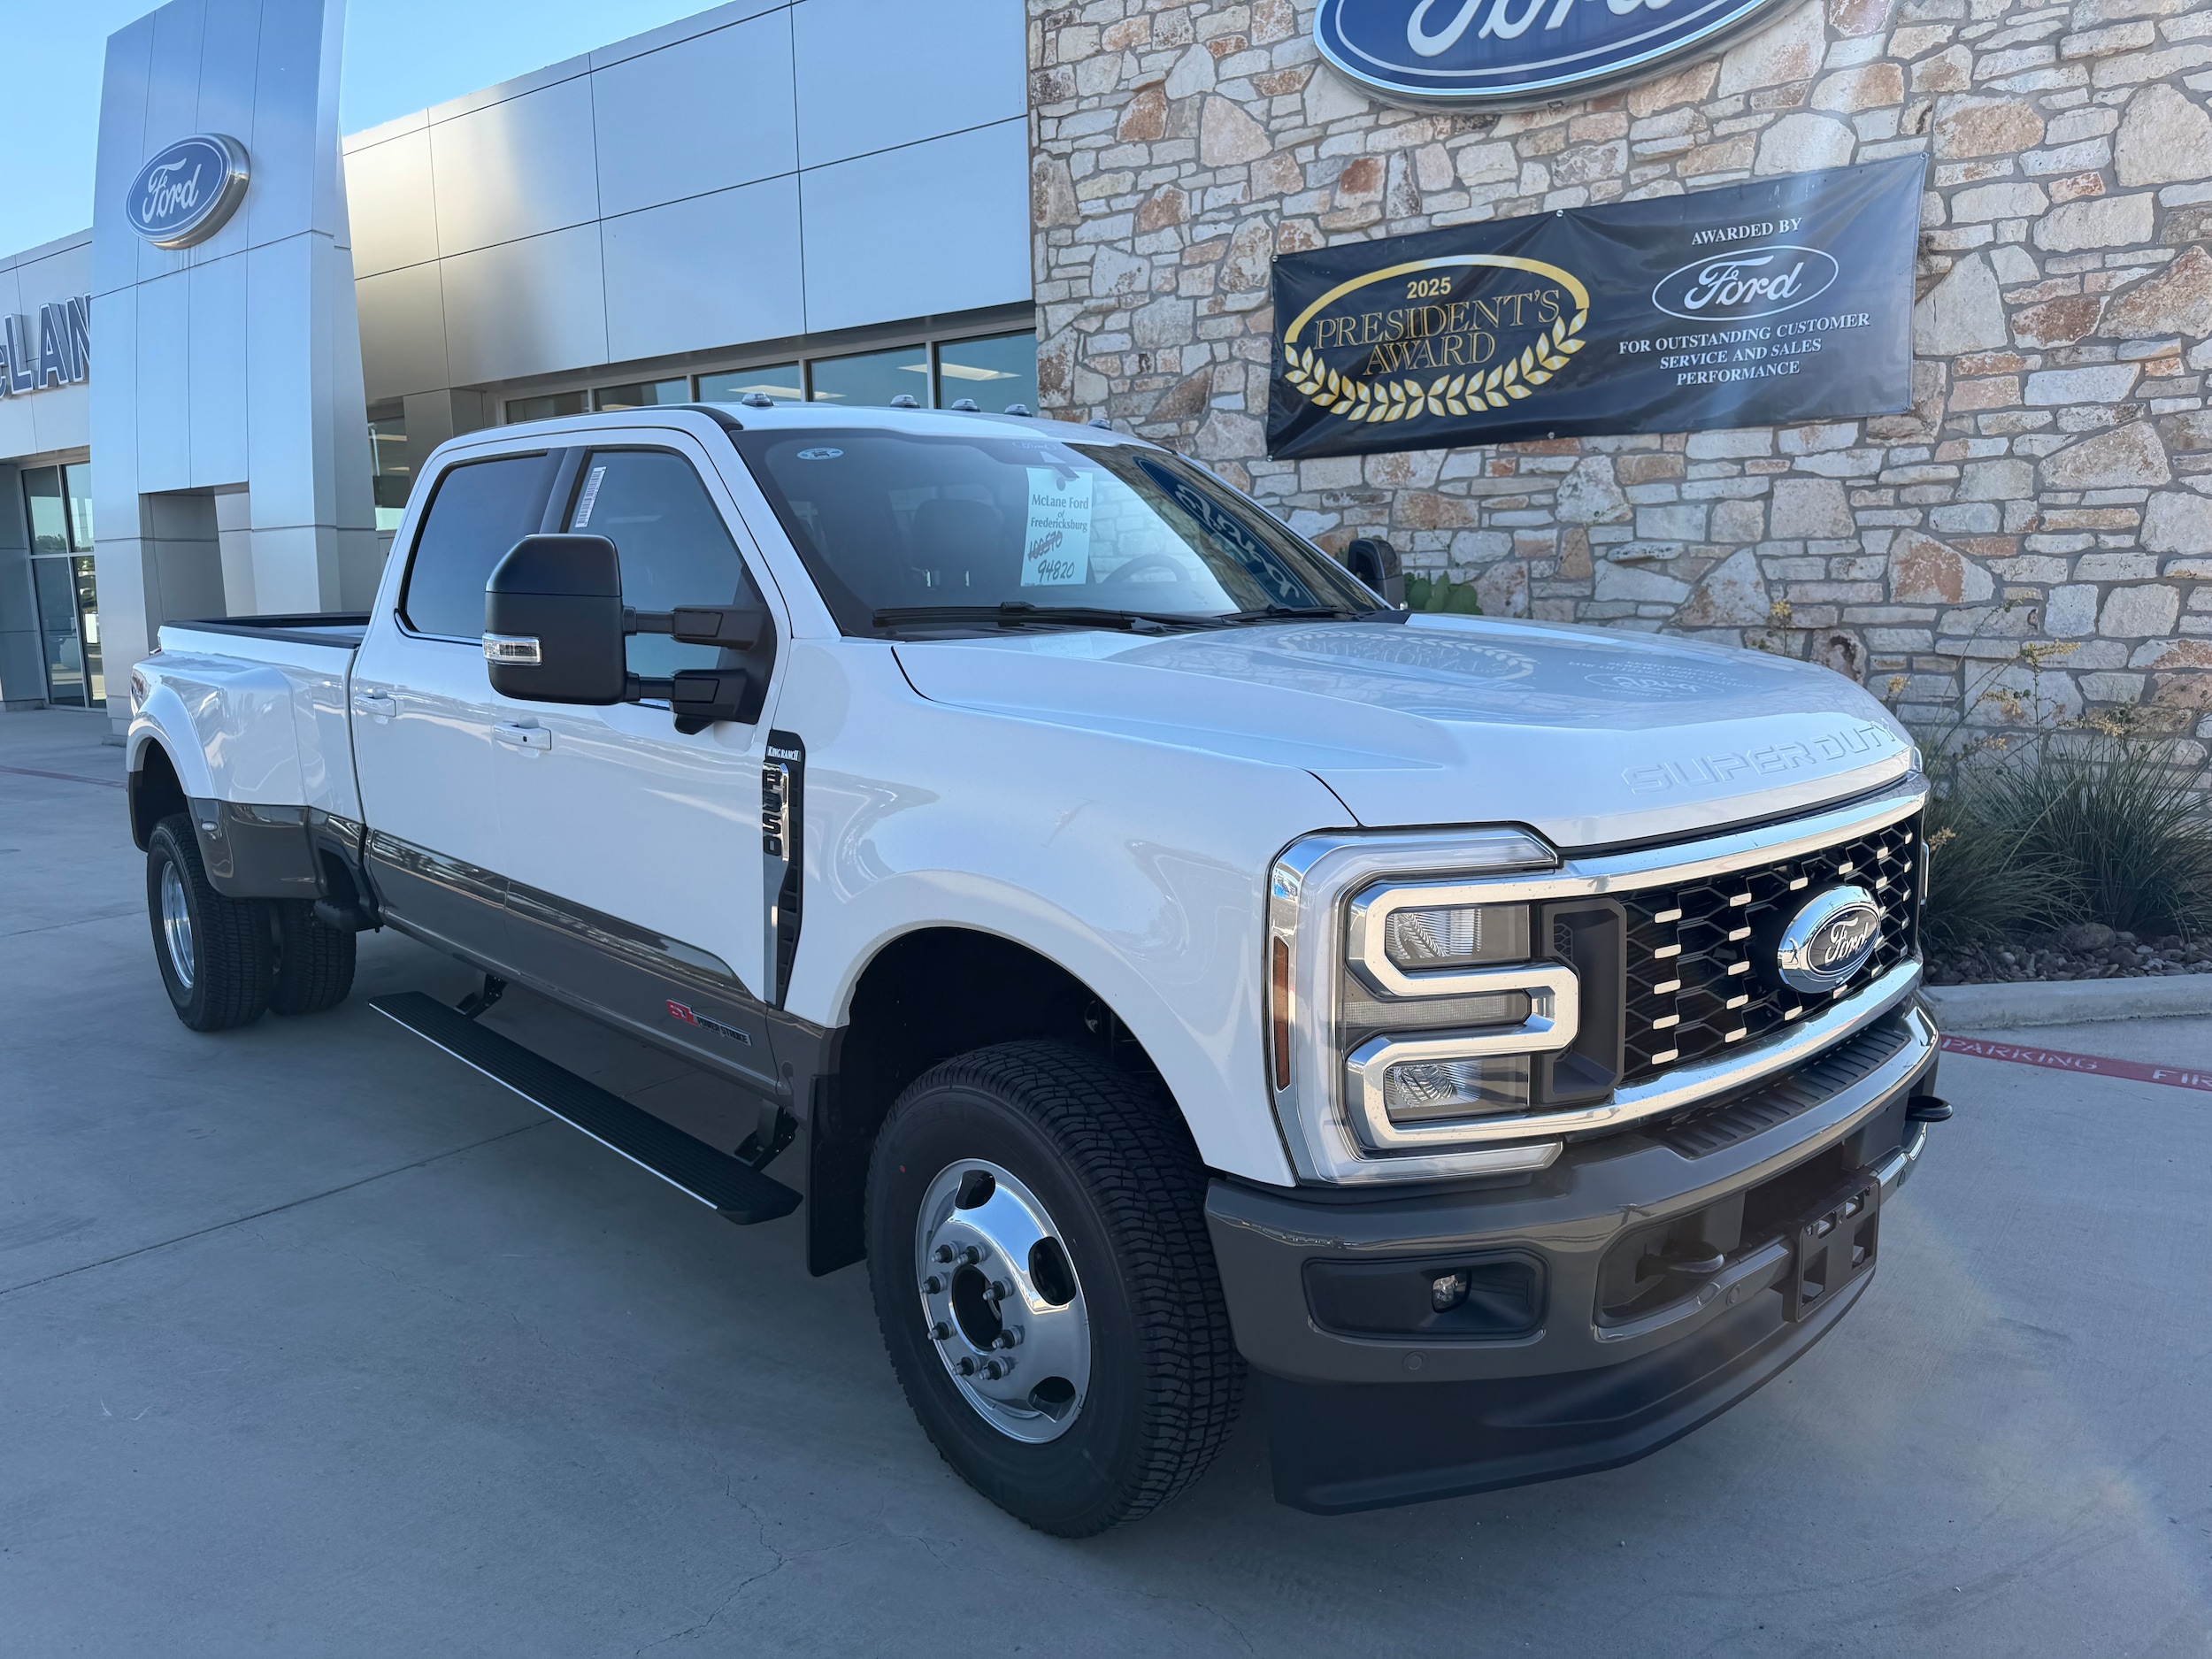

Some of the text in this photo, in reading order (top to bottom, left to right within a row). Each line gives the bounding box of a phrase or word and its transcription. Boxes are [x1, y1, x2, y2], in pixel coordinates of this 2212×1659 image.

[142, 157, 202, 224] Ford
[1691, 217, 1802, 246] AWARDED BY
[1407, 277, 1452, 299] 2025
[1684, 255, 1804, 310] Ford
[1313, 289, 1560, 350] PRESIDENT'S
[1618, 312, 1870, 355] FOR OUTSTANDING CUSTOMER
[0, 292, 90, 398] LAN
[1363, 332, 1495, 376] AWARD
[1660, 338, 1822, 370] SERVICE AND SALES
[1676, 360, 1801, 386] PERFORMANCE
[1032, 494, 1089, 510] McLane Ford
[1030, 517, 1087, 533] Fredericksburg
[1038, 558, 1075, 582] 94820
[767, 745, 799, 761] KING RANCH
[1622, 718, 1898, 795] SUPER DUTY
[1824, 917, 1869, 966] Ford
[1941, 1037, 2098, 1071] PARKING
